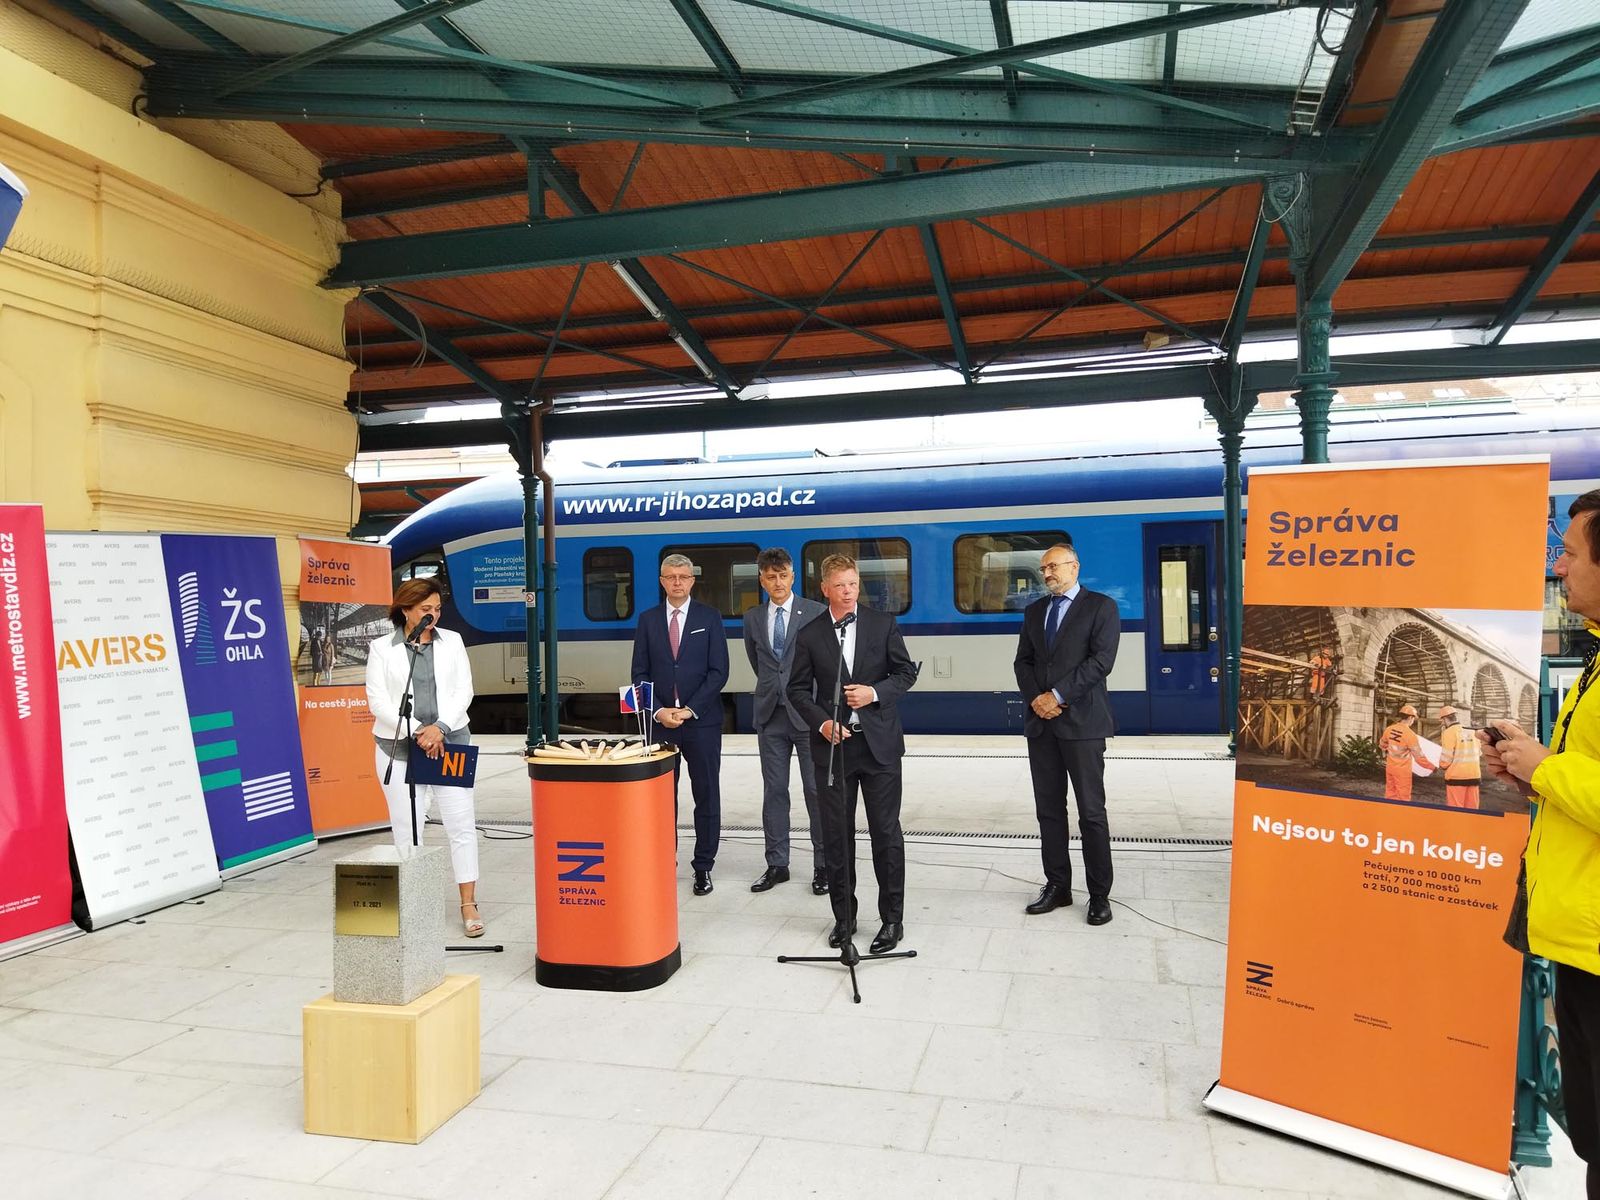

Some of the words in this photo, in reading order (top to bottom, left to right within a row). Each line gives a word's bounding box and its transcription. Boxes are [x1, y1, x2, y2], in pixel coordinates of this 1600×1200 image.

[563, 486, 816, 516] www.rr-jihozapad.cz
[1269, 507, 1399, 539] Správa
[307, 557, 350, 571] Správa
[1267, 542, 1416, 568] železnic
[307, 571, 356, 586] železnic
[0, 532, 32, 720] www.metrostavdiz.cz
[221, 587, 266, 640] ŽS
[57, 633, 167, 671] AVERS
[226, 644, 264, 662] OHLA
[304, 700, 318, 709] Na
[319, 698, 346, 708] cestě
[346, 698, 367, 708] jako
[1252, 814, 1335, 842] Nejsou
[1342, 828, 1369, 848] to
[1372, 832, 1415, 855] jen
[1423, 838, 1505, 870] koleje
[1363, 860, 1415, 875] Pečujeme
[1426, 870, 1438, 879] 10
[1440, 872, 1461, 882] 000
[1464, 875, 1482, 885] km
[1394, 875, 1400, 883] 7
[1402, 877, 1423, 887] 000
[1425, 882, 1460, 893] mostů
[558, 886, 597, 896] SPRÁVA
[559, 896, 606, 906] ŽELEZNIC
[1380, 884, 1400, 894] 500
[1402, 889, 1435, 900] stanic
[1447, 896, 1499, 911] zastávek
